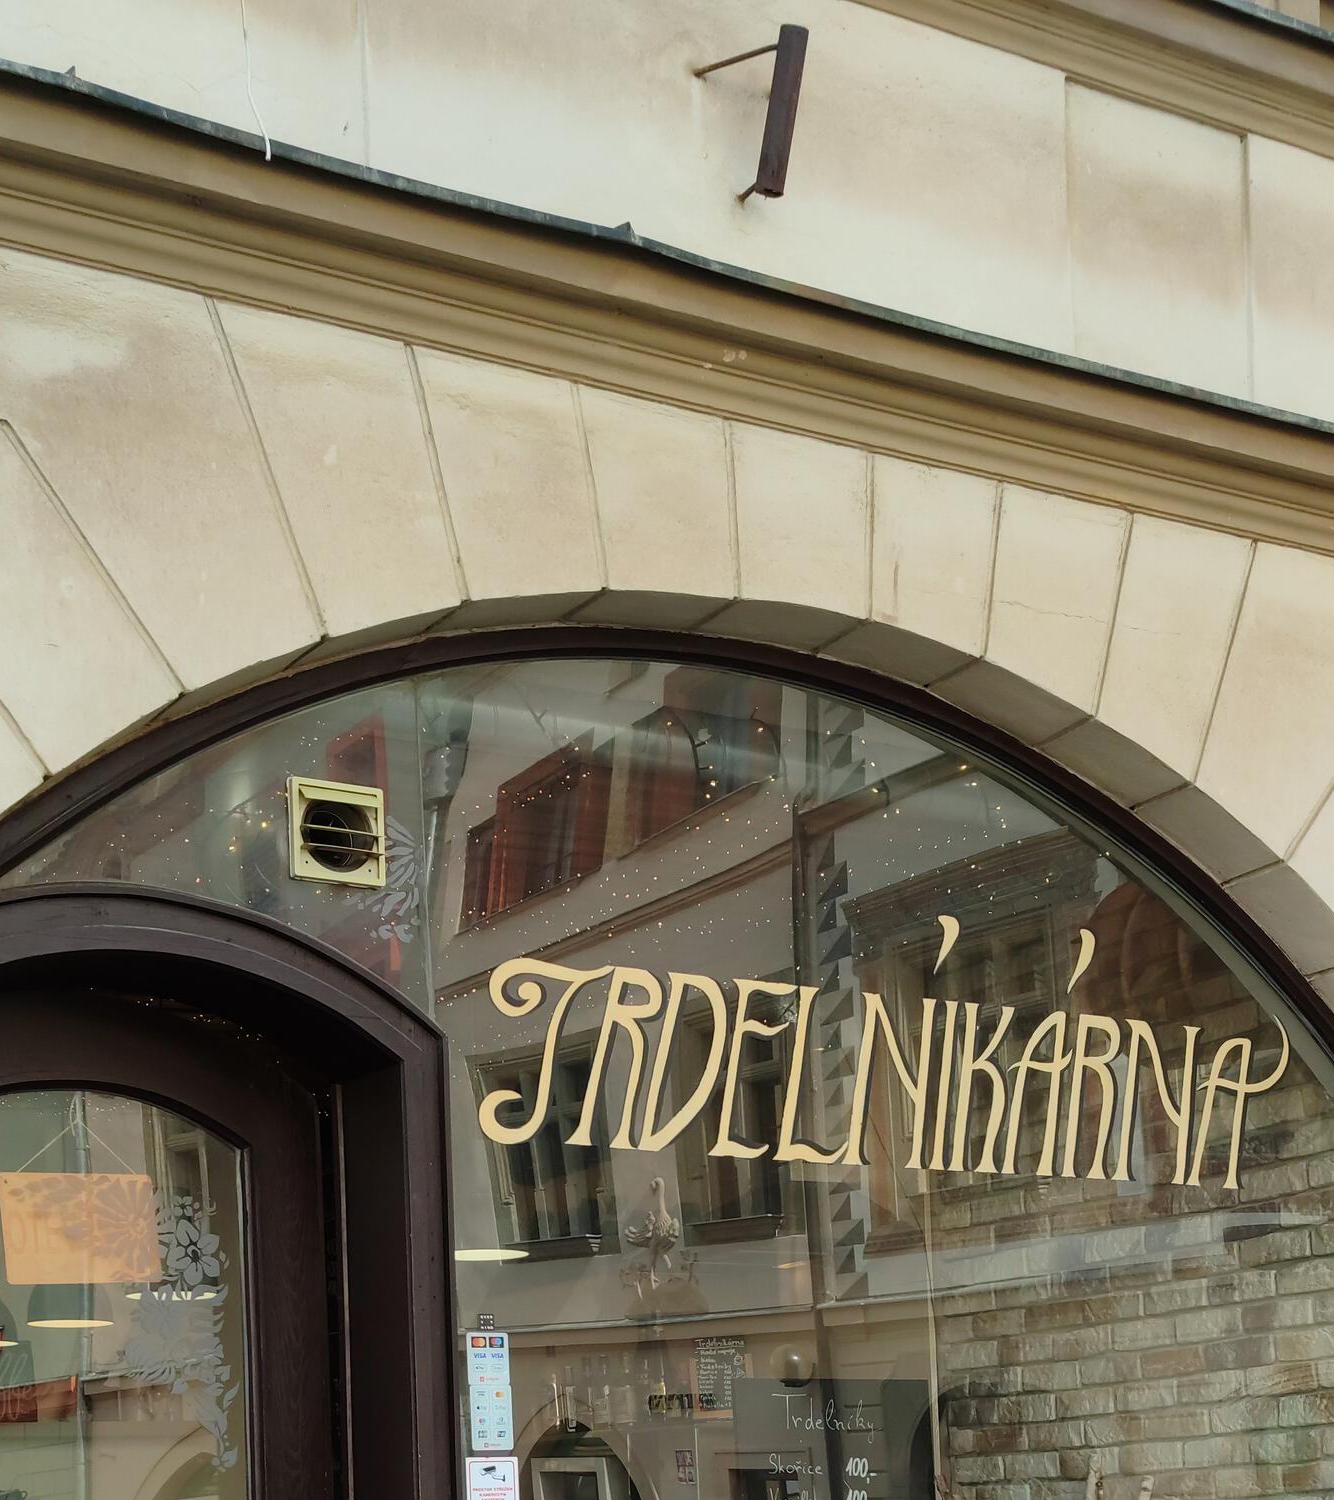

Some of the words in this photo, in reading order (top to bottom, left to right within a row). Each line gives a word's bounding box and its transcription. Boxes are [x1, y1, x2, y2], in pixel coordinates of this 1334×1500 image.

[478, 914, 1290, 1190] TRDELNÍKÁRNA
[771, 1393, 876, 1444] Trdelníky
[769, 1453, 824, 1475] Skořice
[846, 1457, 877, 1484] 100,-
